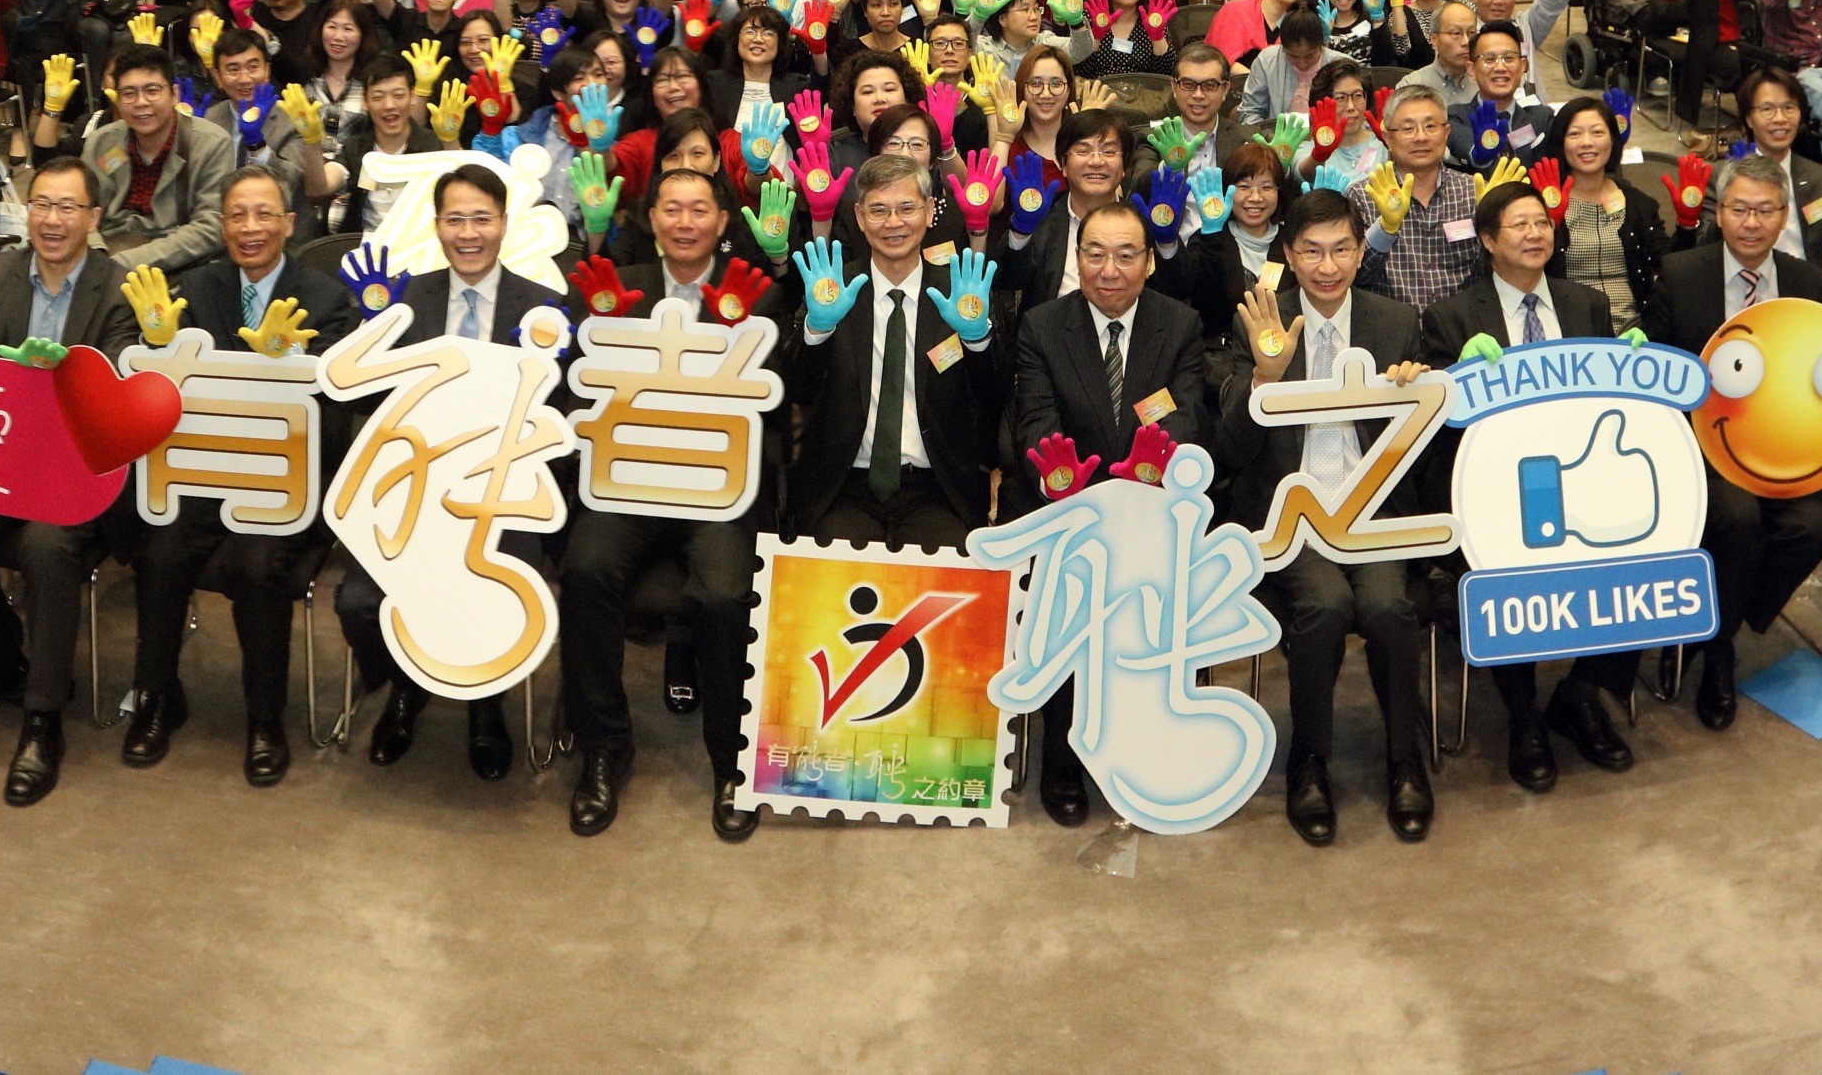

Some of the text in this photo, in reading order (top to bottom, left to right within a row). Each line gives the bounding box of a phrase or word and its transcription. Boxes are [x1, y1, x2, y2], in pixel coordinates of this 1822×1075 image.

[1455, 351, 1691, 409] THANK YOU
[1480, 578, 1702, 638] 100K LIKES
